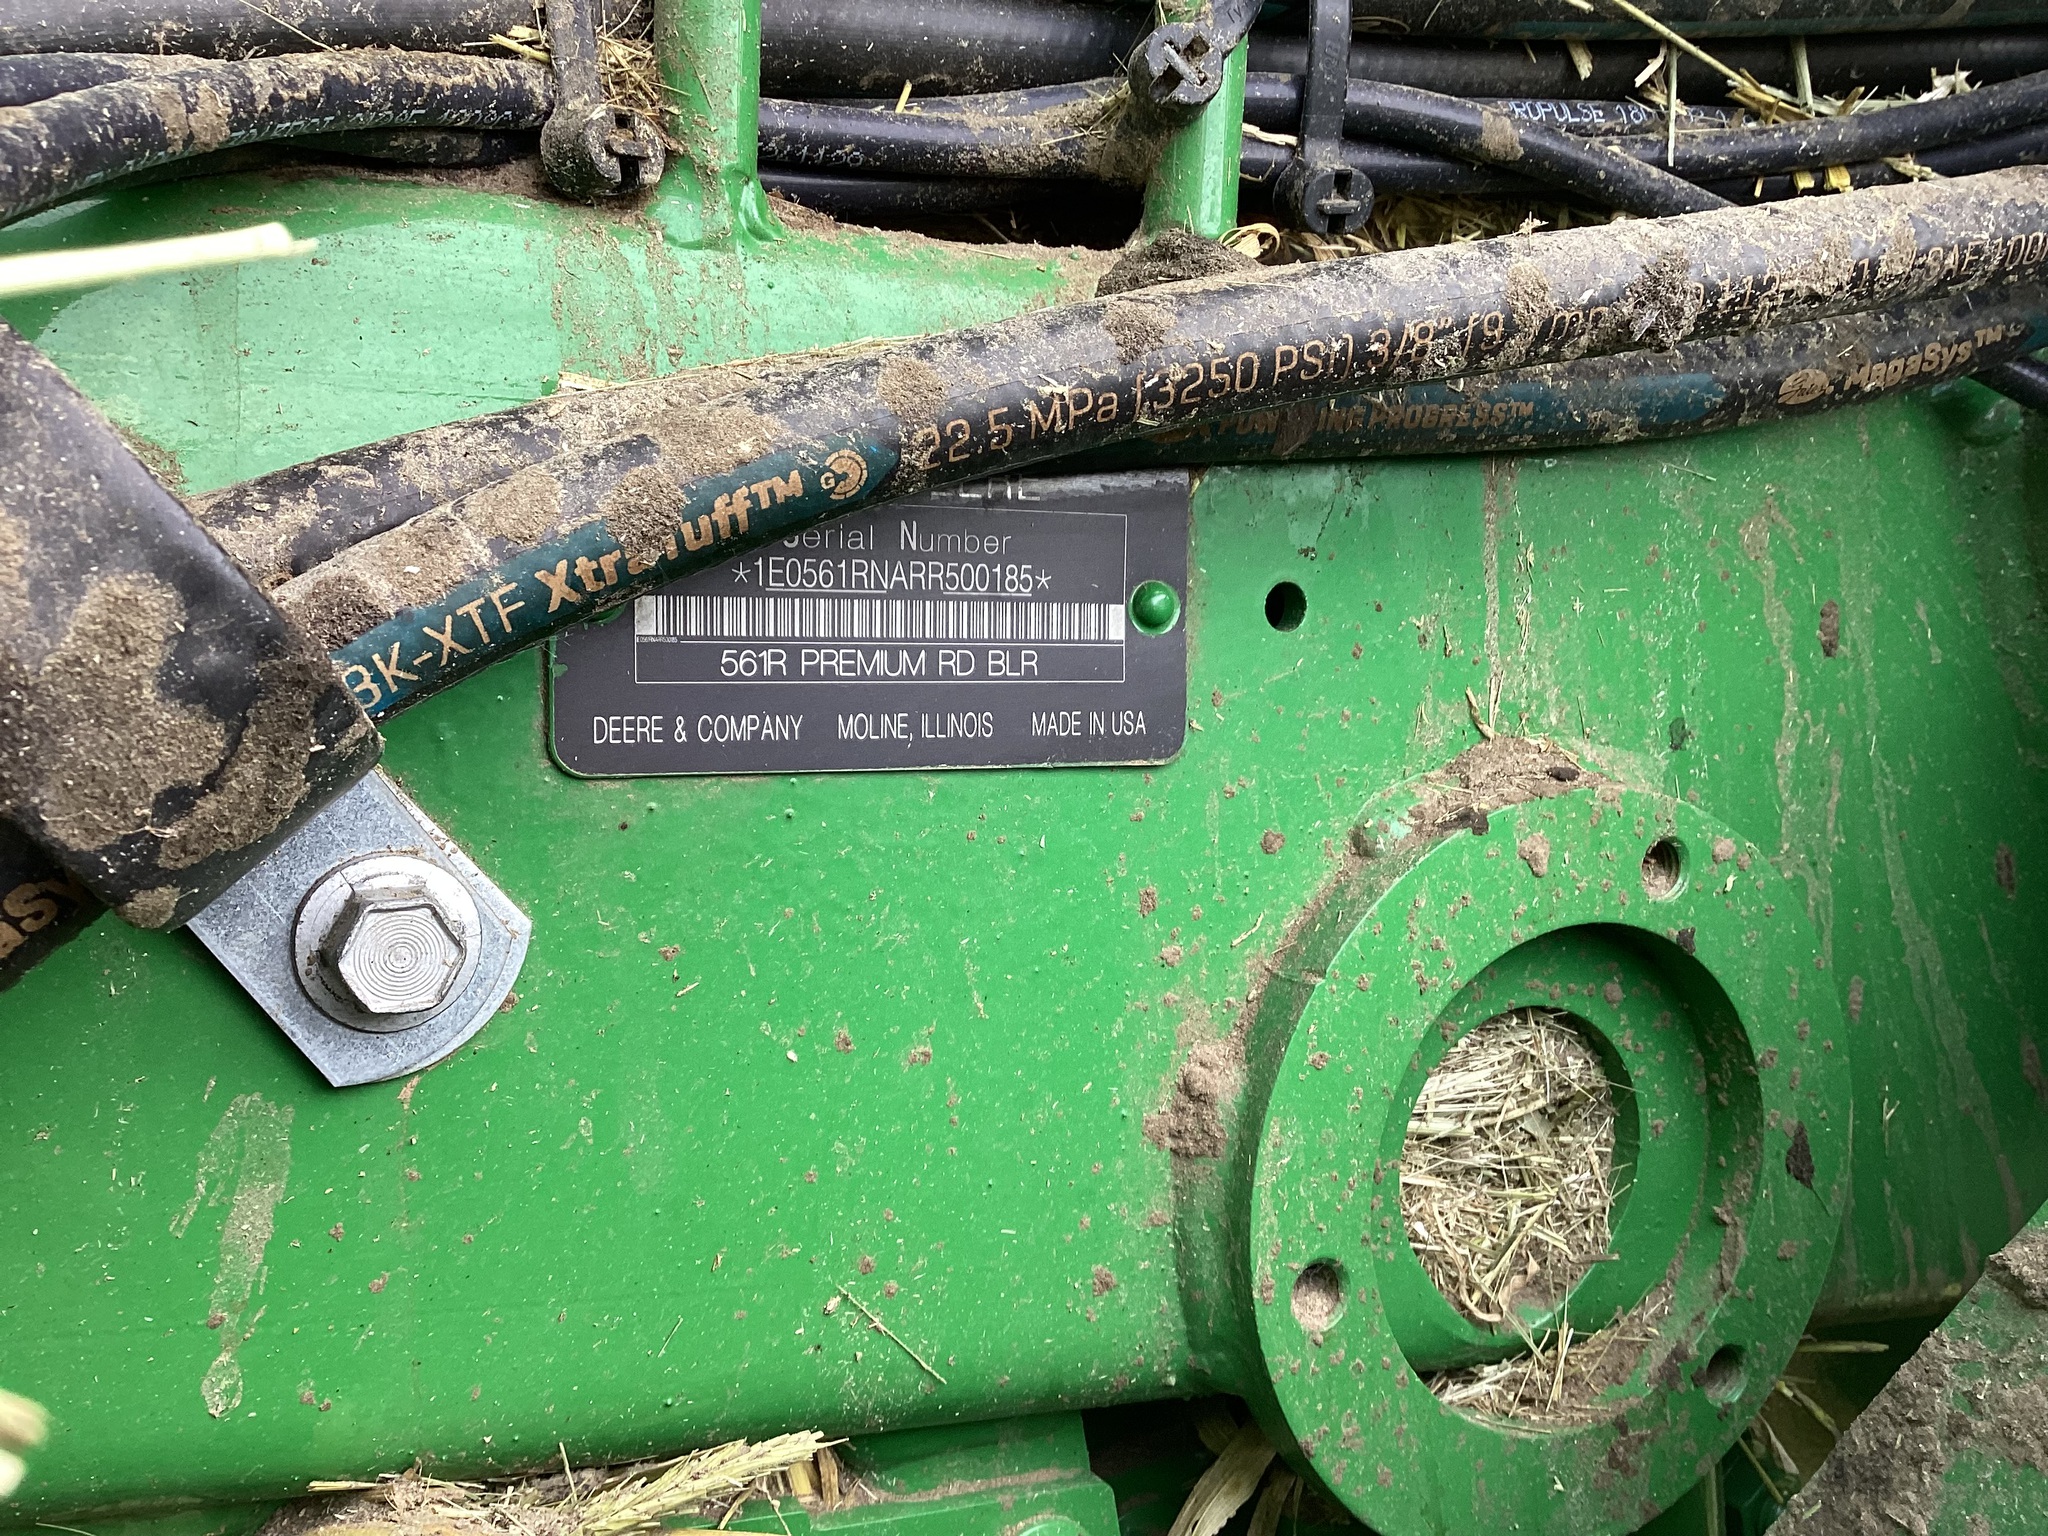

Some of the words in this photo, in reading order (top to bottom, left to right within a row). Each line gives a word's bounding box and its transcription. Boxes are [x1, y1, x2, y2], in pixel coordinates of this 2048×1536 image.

[912, 406, 1014, 471] 22.5
[1030, 386, 1119, 440] MPa
[1134, 350, 1261, 422] (3250
[900, 520, 1012, 555] Number
[720, 649, 787, 677] 561R
[800, 649, 926, 677] PREMIUM
[939, 650, 976, 677] RD
[987, 650, 1039, 677] BLR
[593, 715, 665, 744] DEERE
[673, 715, 688, 742] &
[697, 714, 804, 743] COMPANY
[837, 713, 914, 742] MOLINE,
[921, 712, 995, 739] ILLINOIS
[1031, 711, 1083, 737] MADE
[1089, 711, 1105, 736] IN
[1111, 711, 1148, 736] USA
